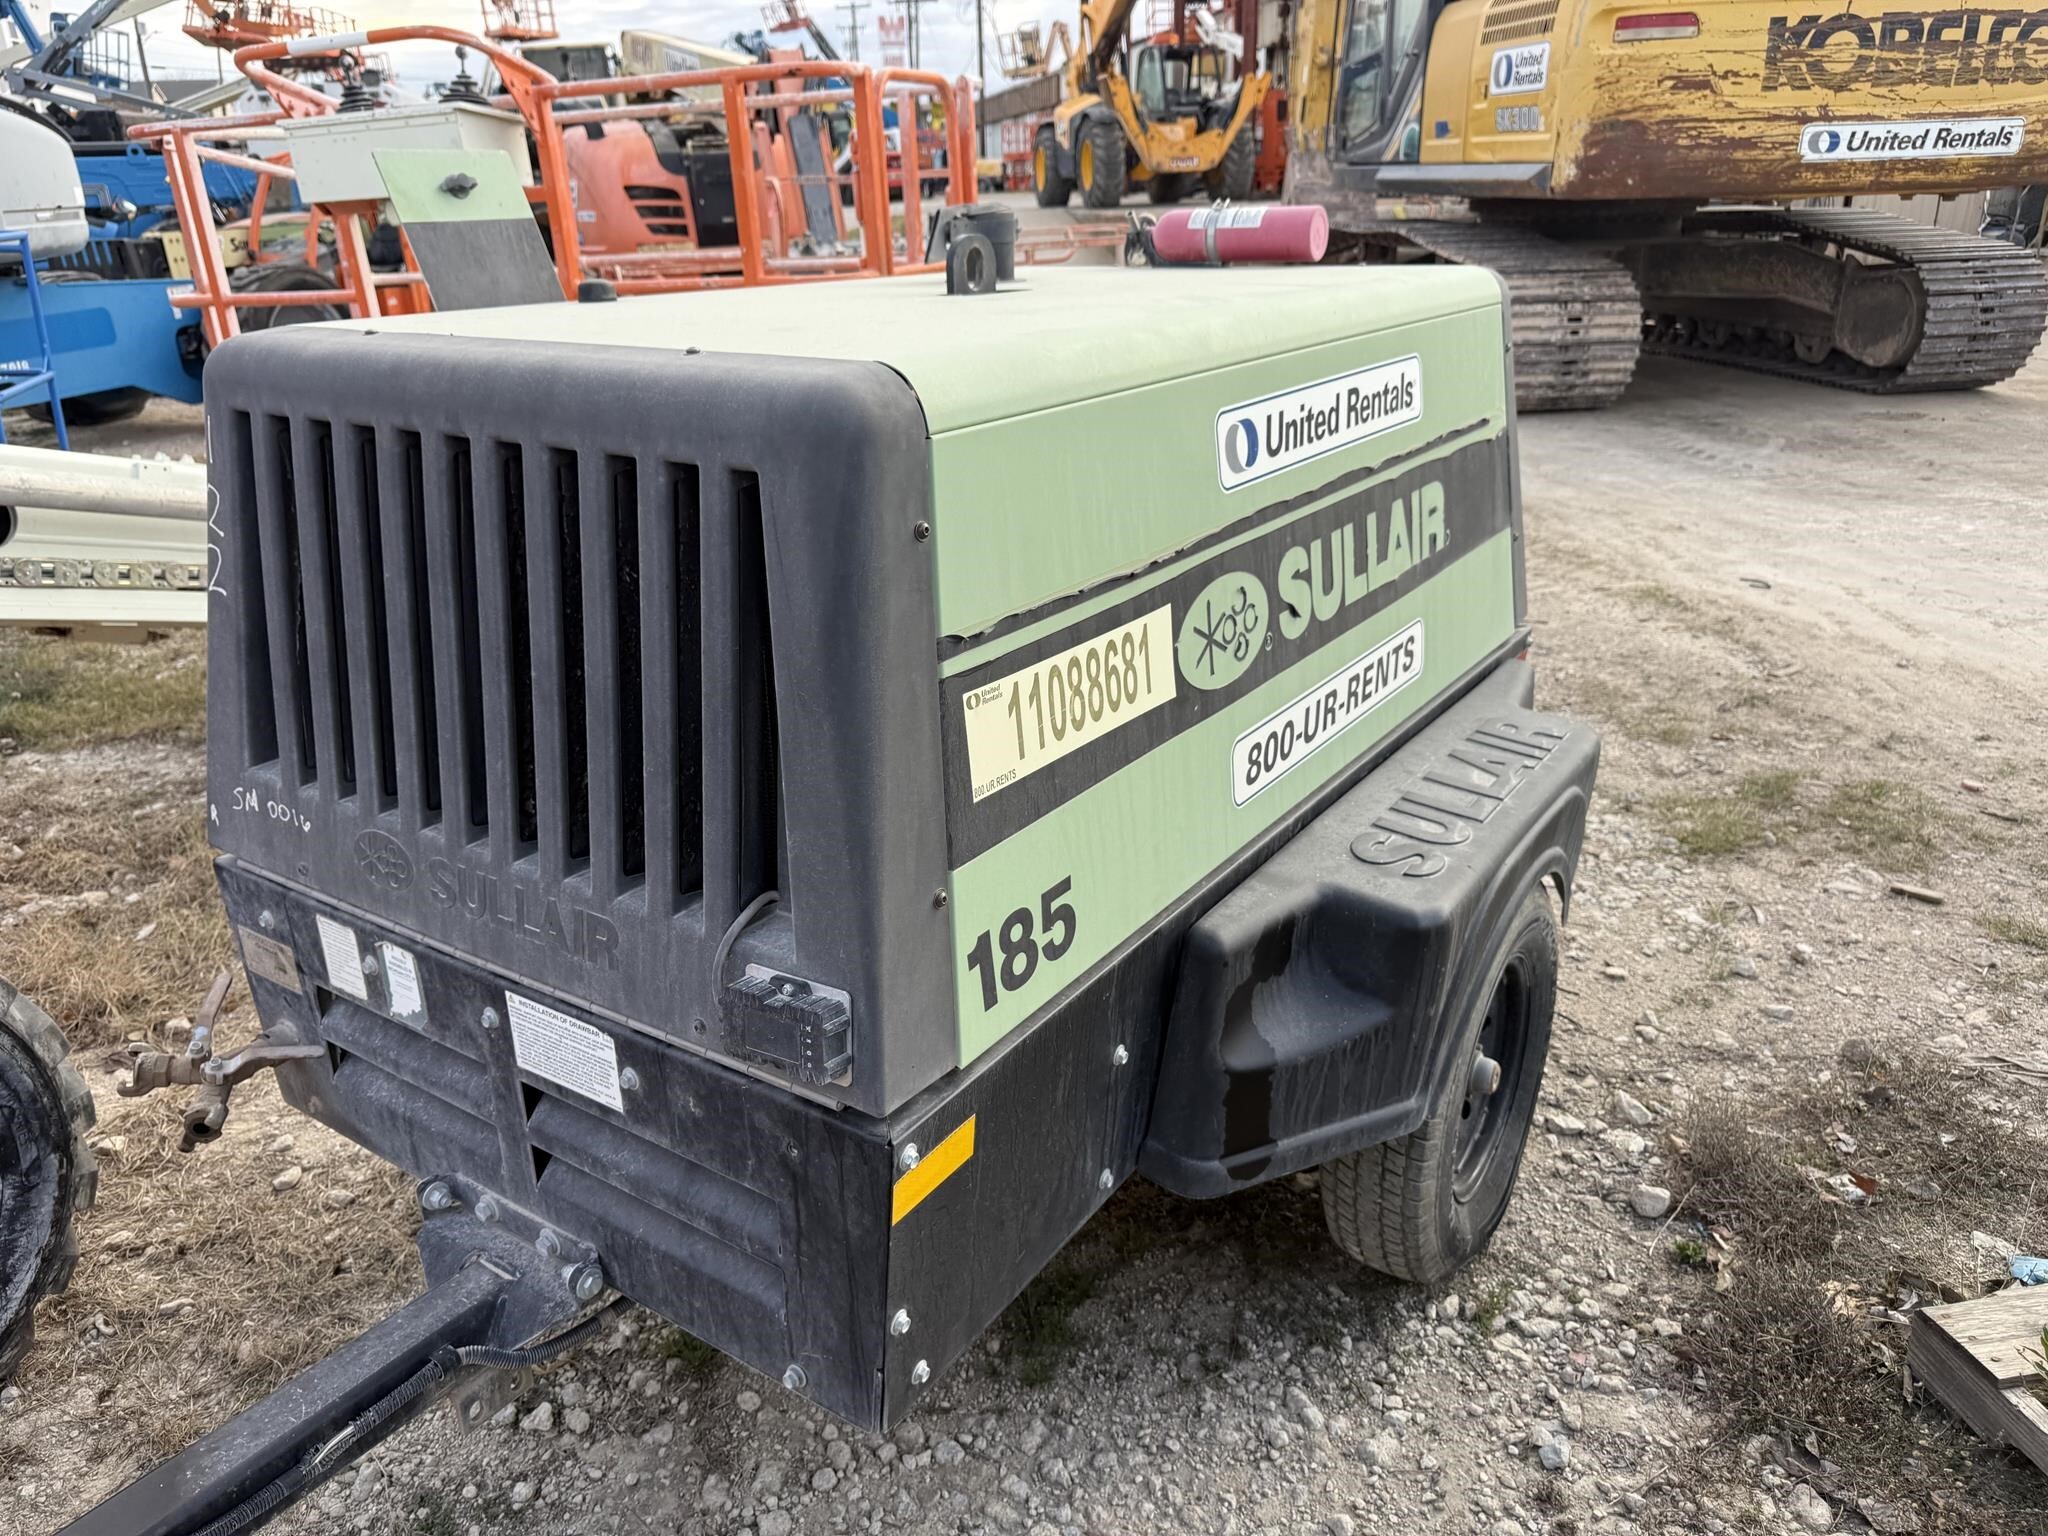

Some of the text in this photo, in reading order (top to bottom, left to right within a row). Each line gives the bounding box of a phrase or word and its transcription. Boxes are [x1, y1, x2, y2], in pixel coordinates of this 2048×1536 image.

[1513, 67, 1544, 87] Rentals
[1515, 48, 1546, 69] United
[1847, 125, 2014, 152] United Rentals
[1266, 372, 1413, 457] United Rentals
[1278, 480, 1445, 640] SULLAIR
[981, 684, 1001, 698] United
[1008, 623, 1152, 760] 11088681
[1246, 635, 1414, 785] 800-UR-RENTS
[232, 786, 311, 832] SM 0016
[1350, 722, 1569, 877] SULLAIR
[427, 856, 620, 972] SULLAIR
[967, 874, 1076, 1012] 185
